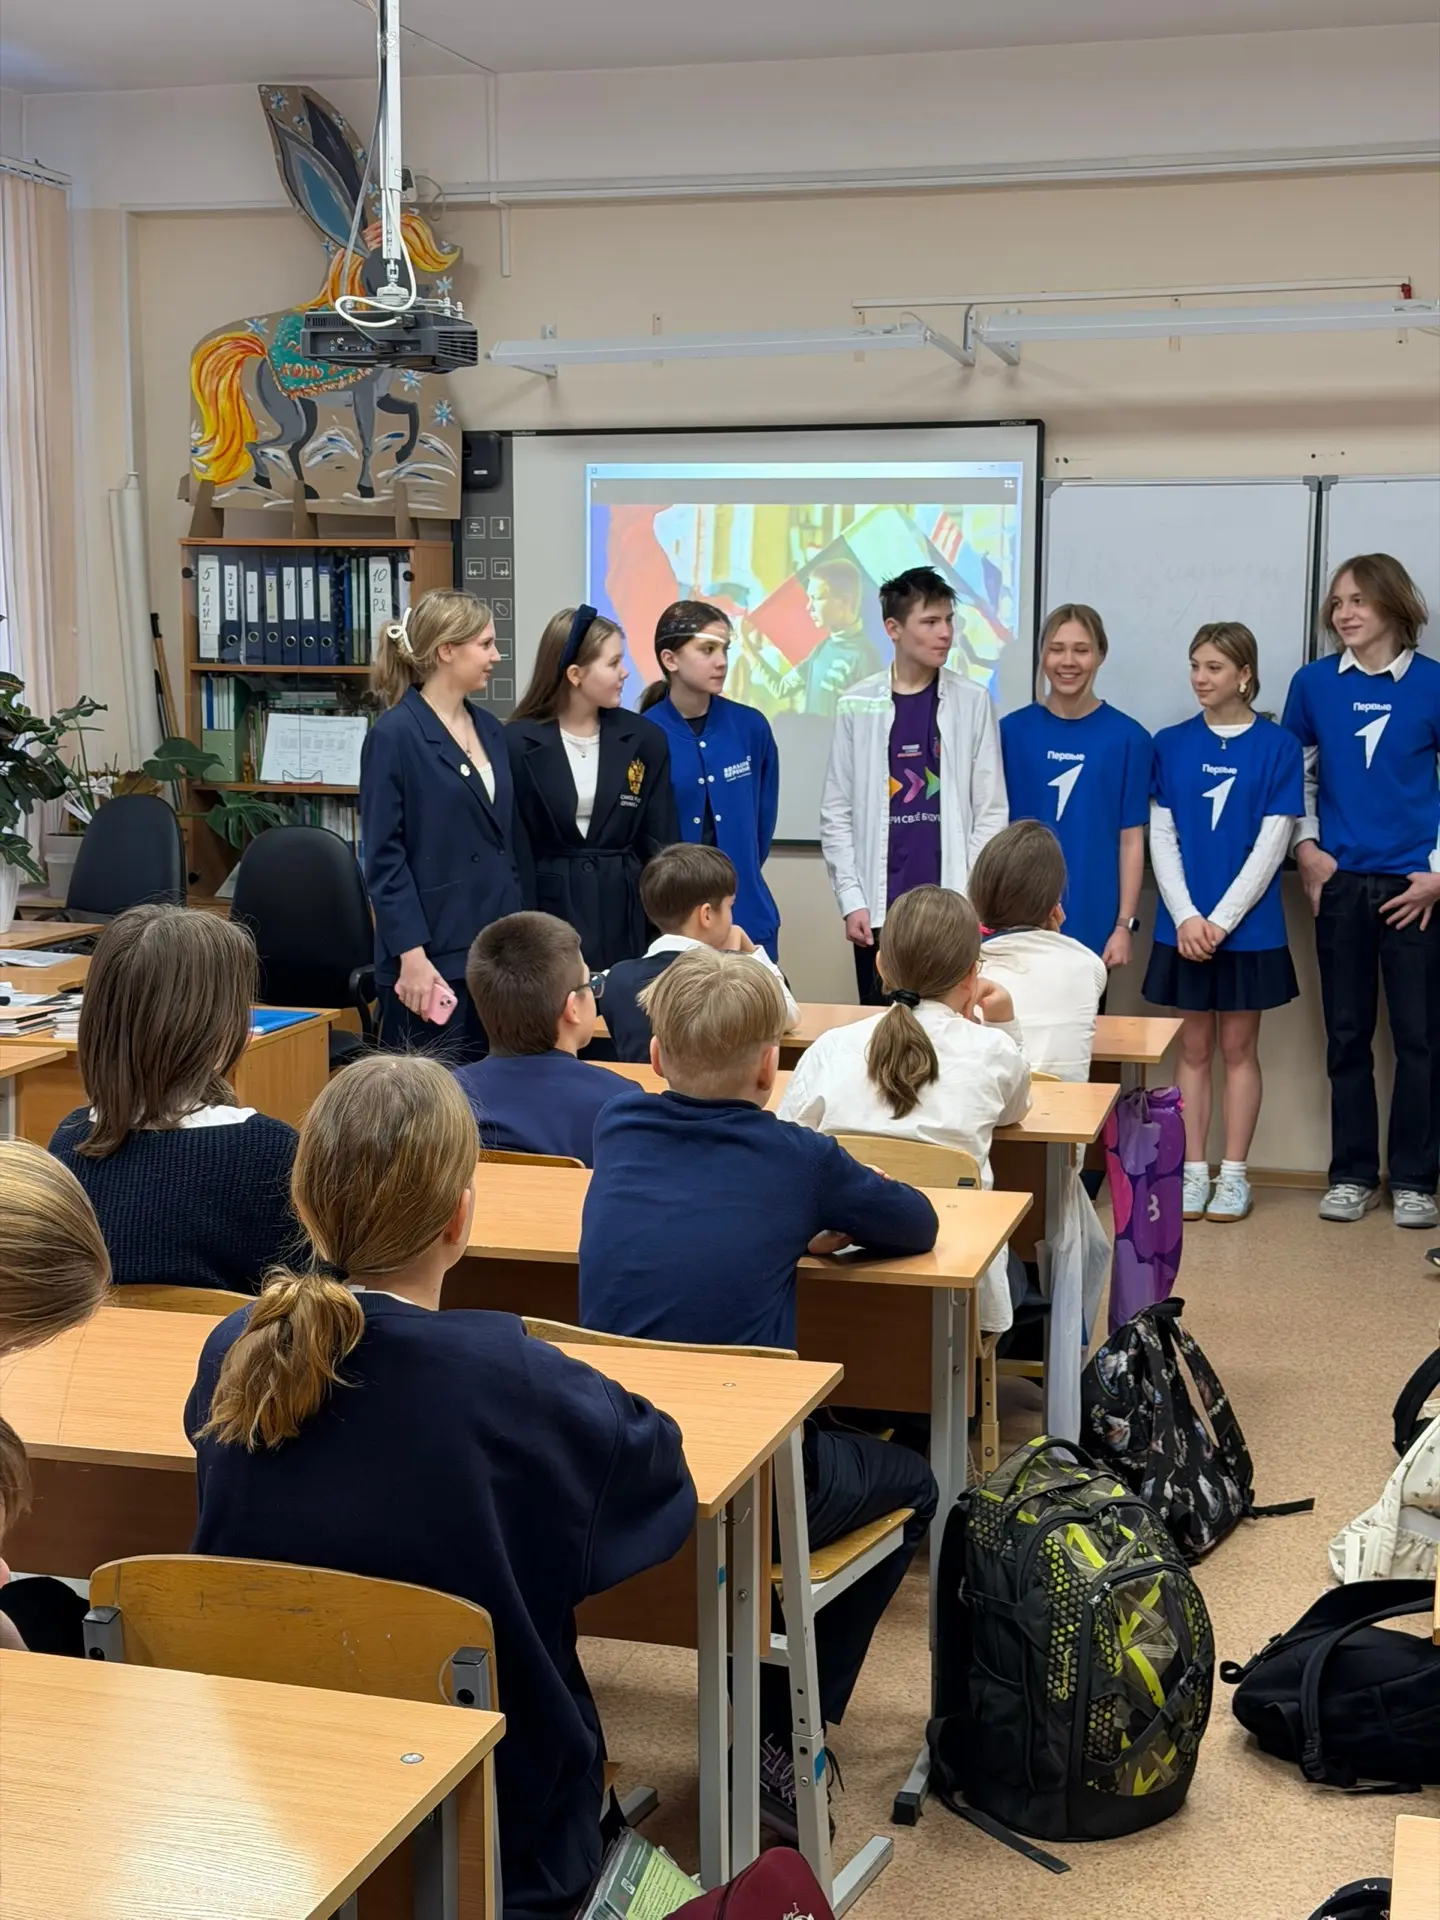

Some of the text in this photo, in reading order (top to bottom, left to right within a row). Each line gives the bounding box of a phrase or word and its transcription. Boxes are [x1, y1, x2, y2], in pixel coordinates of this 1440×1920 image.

[373, 568, 388, 583] 10
[248, 584, 256, 595] 2
[1353, 701, 1393, 713] Первые
[1047, 750, 1086, 762] Первые
[1202, 763, 1238, 776] Первые
